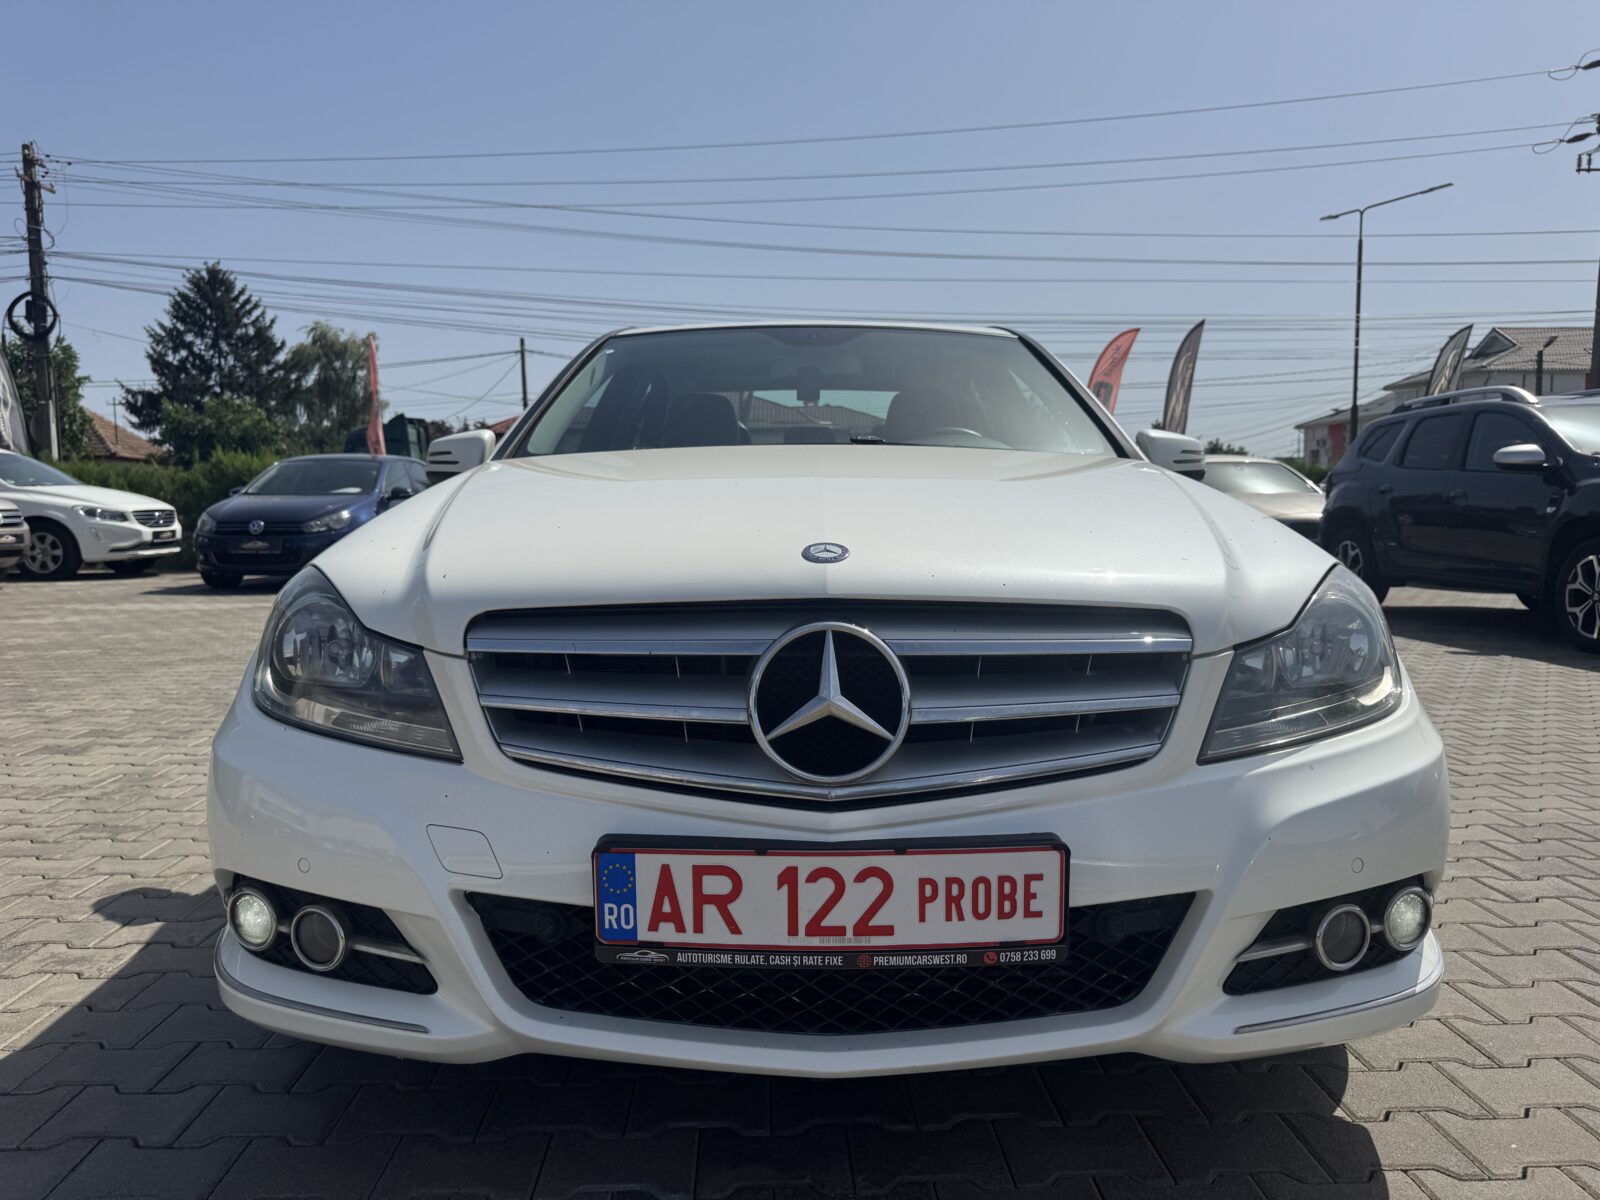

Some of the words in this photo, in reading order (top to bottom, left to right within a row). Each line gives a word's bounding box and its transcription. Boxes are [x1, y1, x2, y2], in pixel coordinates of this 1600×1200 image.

[647, 864, 743, 935] AR
[777, 866, 895, 937] 122
[918, 873, 1044, 923] PROBE
[604, 903, 634, 930] RO
[677, 952, 733, 965] AUTOTURISME
[734, 954, 768, 966] RULATE,
[769, 955, 790, 966] CASH
[802, 956, 823, 966] RATE
[824, 956, 843, 966] FIXE
[873, 953, 968, 966] PREMIUMCARSWEST.RO
[1000, 951, 1022, 963] 0758
[1023, 951, 1039, 962] 233
[1041, 949, 1056, 960] 699
